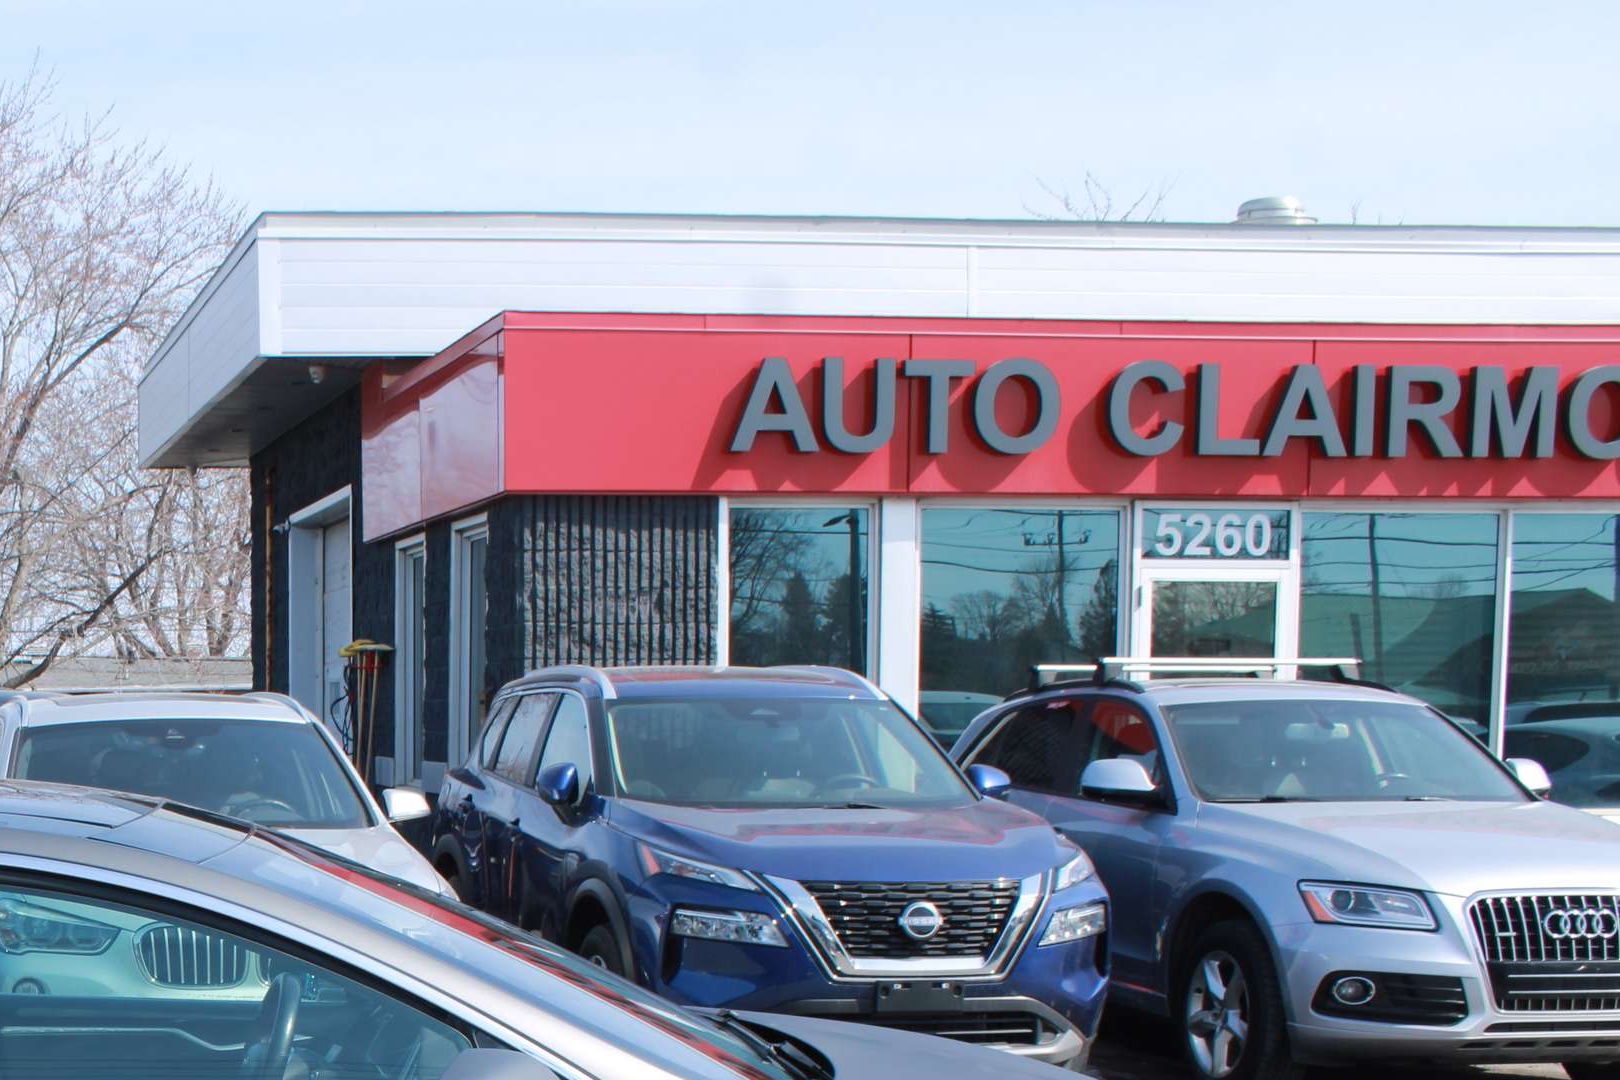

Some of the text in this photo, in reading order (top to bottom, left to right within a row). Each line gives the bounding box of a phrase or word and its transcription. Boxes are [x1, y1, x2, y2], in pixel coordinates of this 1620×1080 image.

[729, 356, 1620, 461] AUTO CLAIRMO
[1155, 513, 1272, 557] 5260
